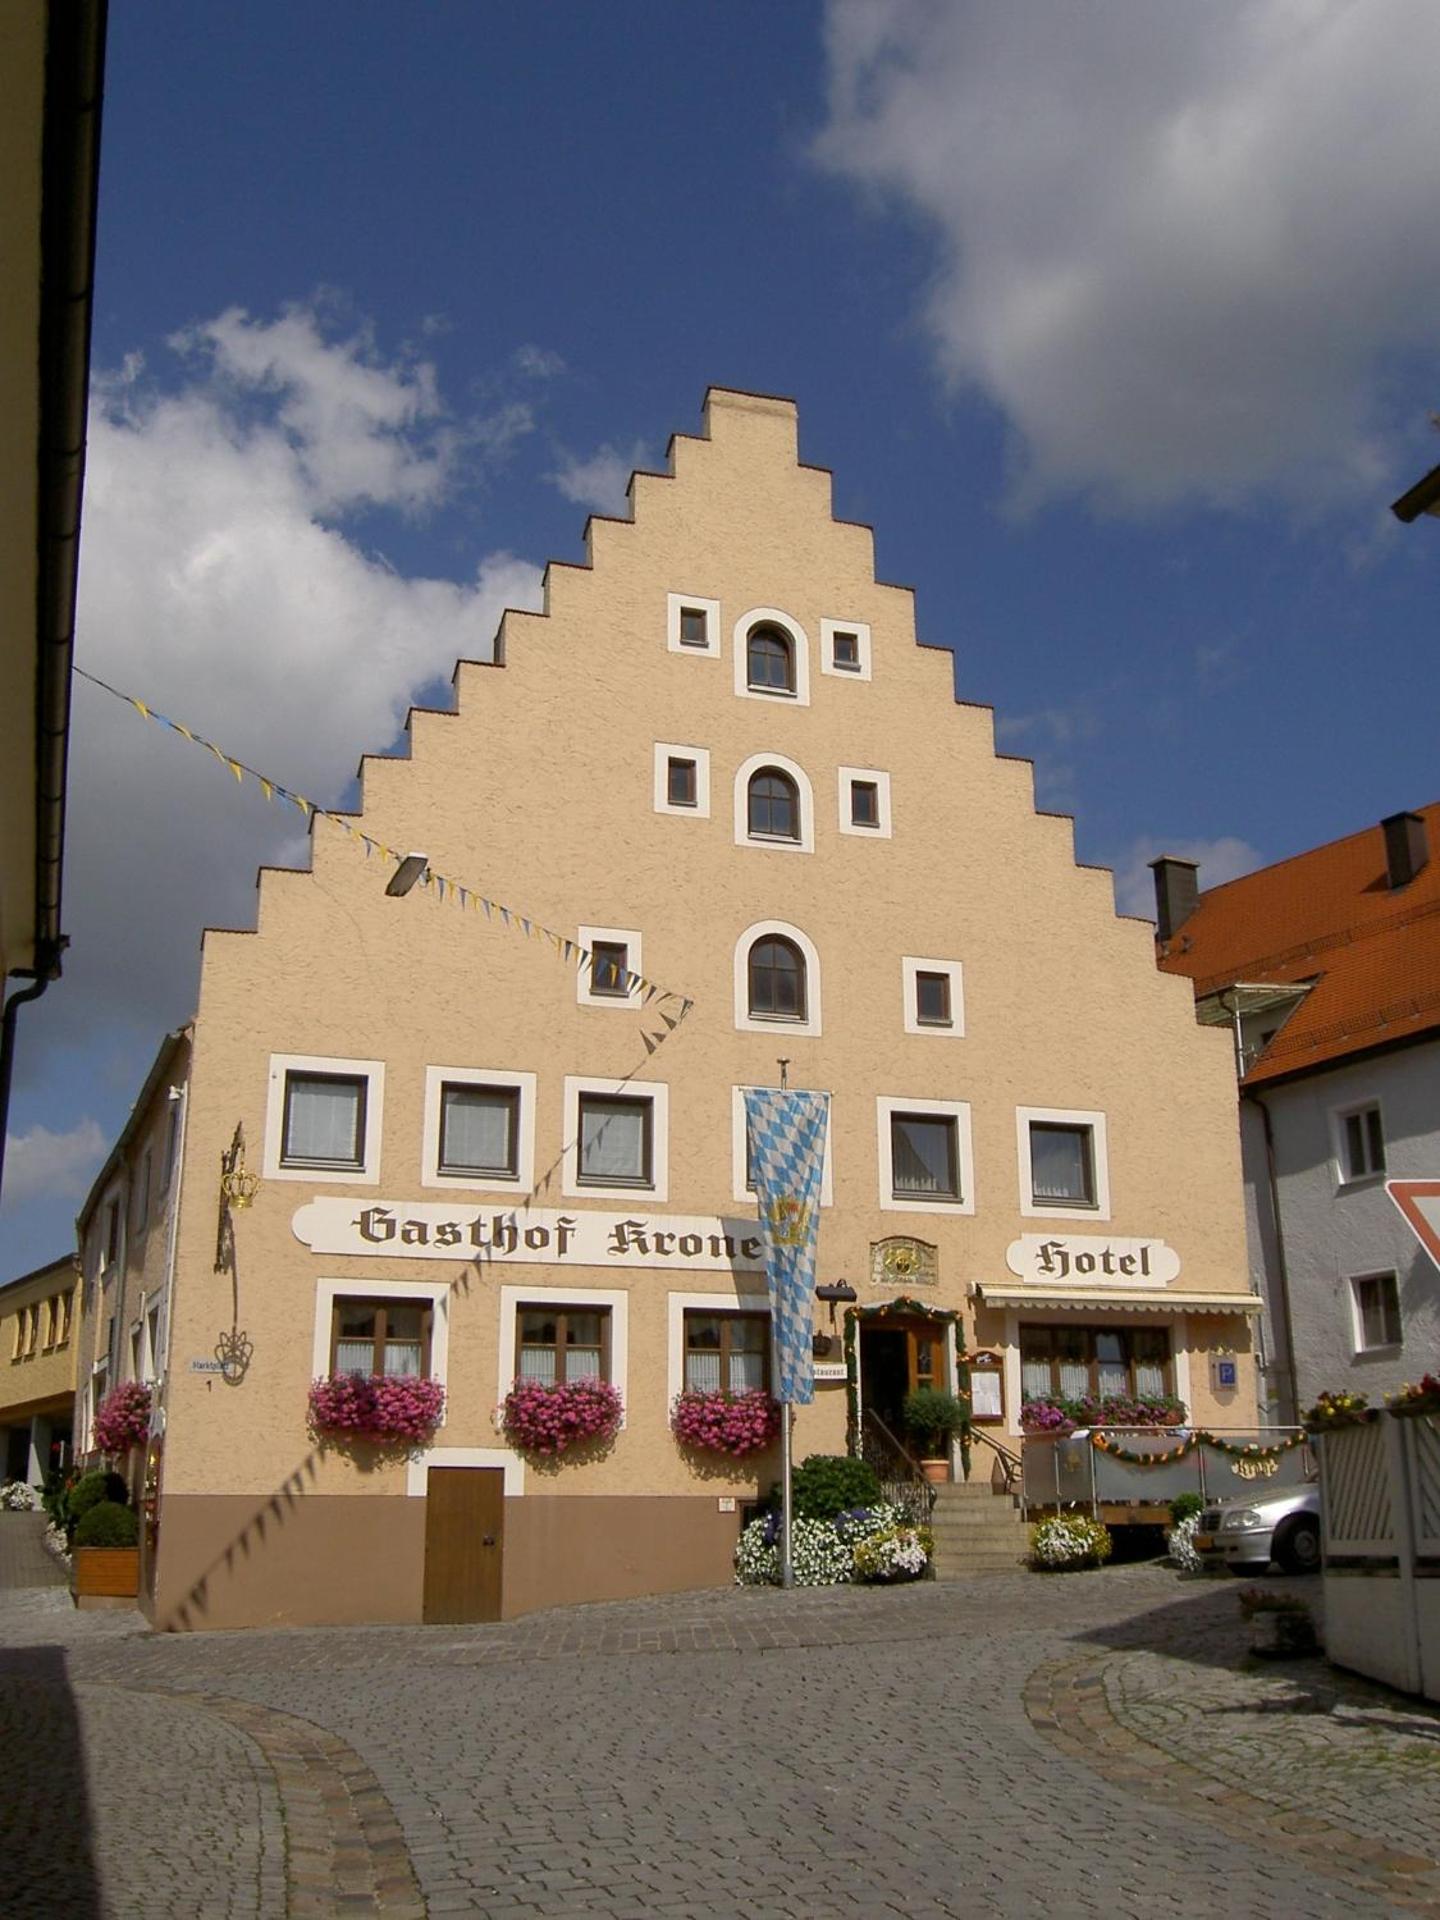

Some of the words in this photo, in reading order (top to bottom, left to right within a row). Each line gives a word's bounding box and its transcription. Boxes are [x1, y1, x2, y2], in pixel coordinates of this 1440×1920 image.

[351, 1207, 577, 1257] Gasthof
[607, 1219, 762, 1260] Krone
[1035, 1240, 1150, 1279] Hotel
[206, 1380, 212, 1392] 1
